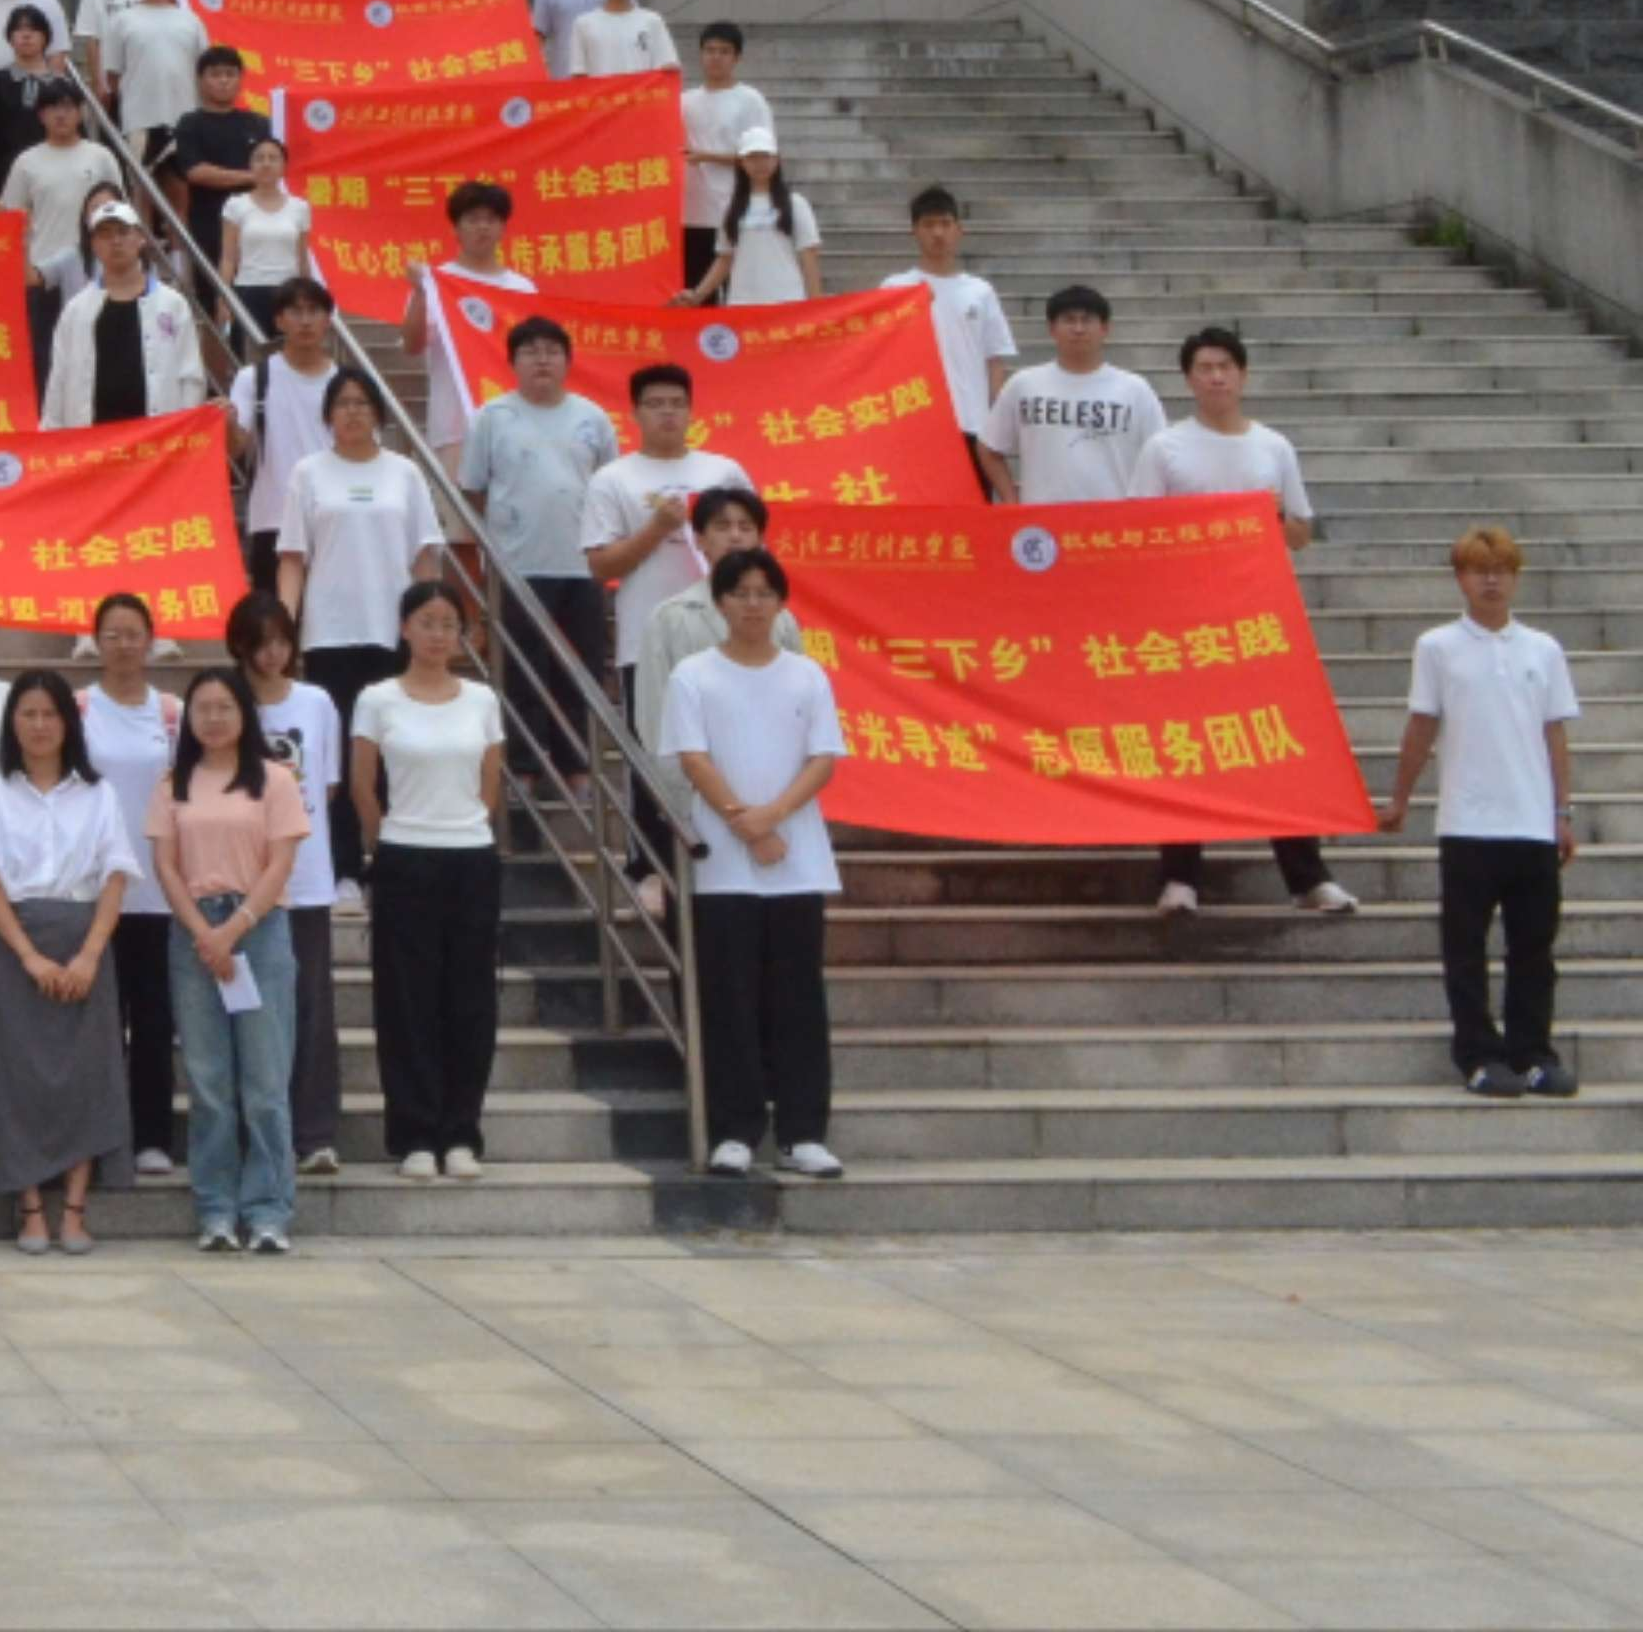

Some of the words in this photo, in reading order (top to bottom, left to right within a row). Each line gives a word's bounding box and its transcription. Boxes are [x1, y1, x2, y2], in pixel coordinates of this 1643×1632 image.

[535, 158, 671, 201] 社会实践
[759, 376, 934, 449] 社会实践
[30, 515, 216, 571] 社会实践
[857, 634, 1053, 683] “三下乡”
[1082, 612, 1293, 680] 社会实践
[1022, 704, 1307, 781] 志愿服务团队
